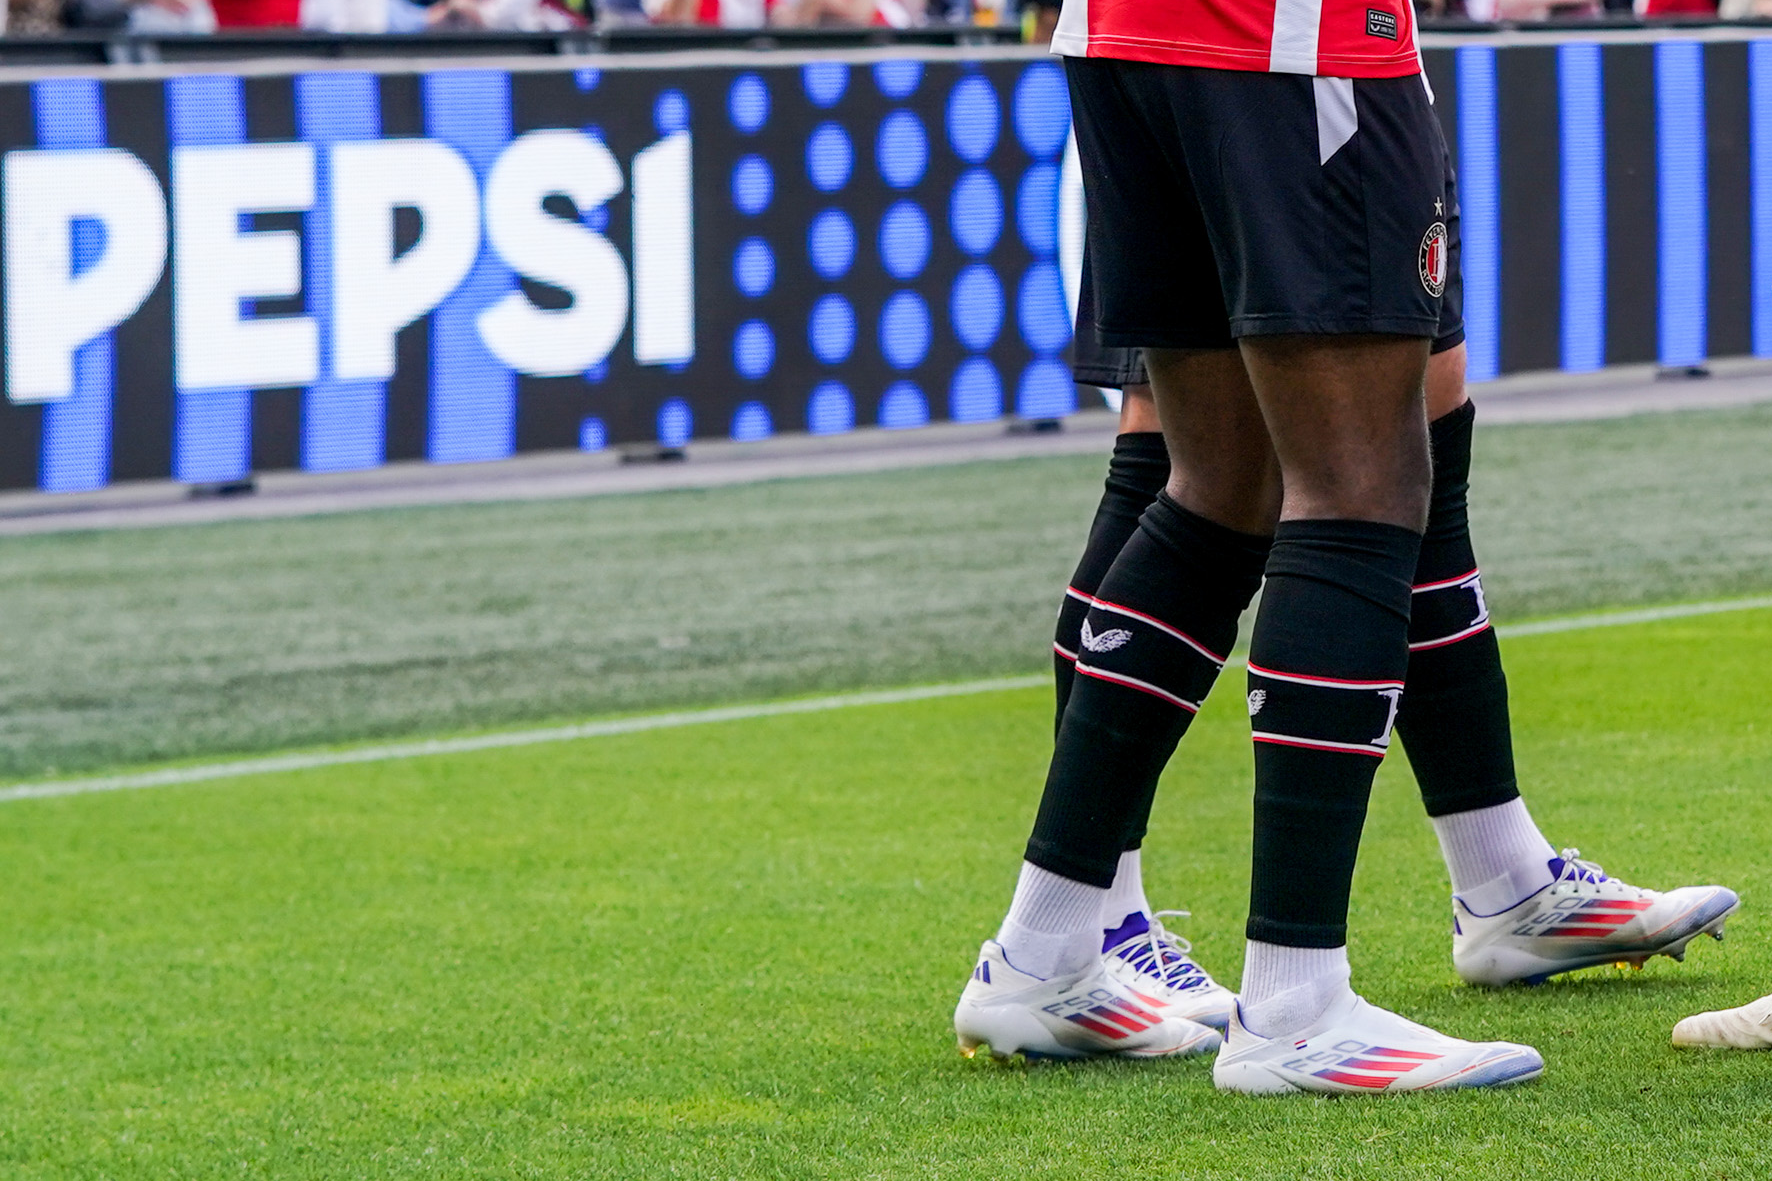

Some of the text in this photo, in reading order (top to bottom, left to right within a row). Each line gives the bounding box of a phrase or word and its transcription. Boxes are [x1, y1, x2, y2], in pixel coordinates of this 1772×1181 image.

[3, 127, 695, 405] PEPSI
[1511, 897, 1586, 937] F50
[1041, 988, 1114, 1017] F50
[1281, 1039, 1369, 1074] F50
